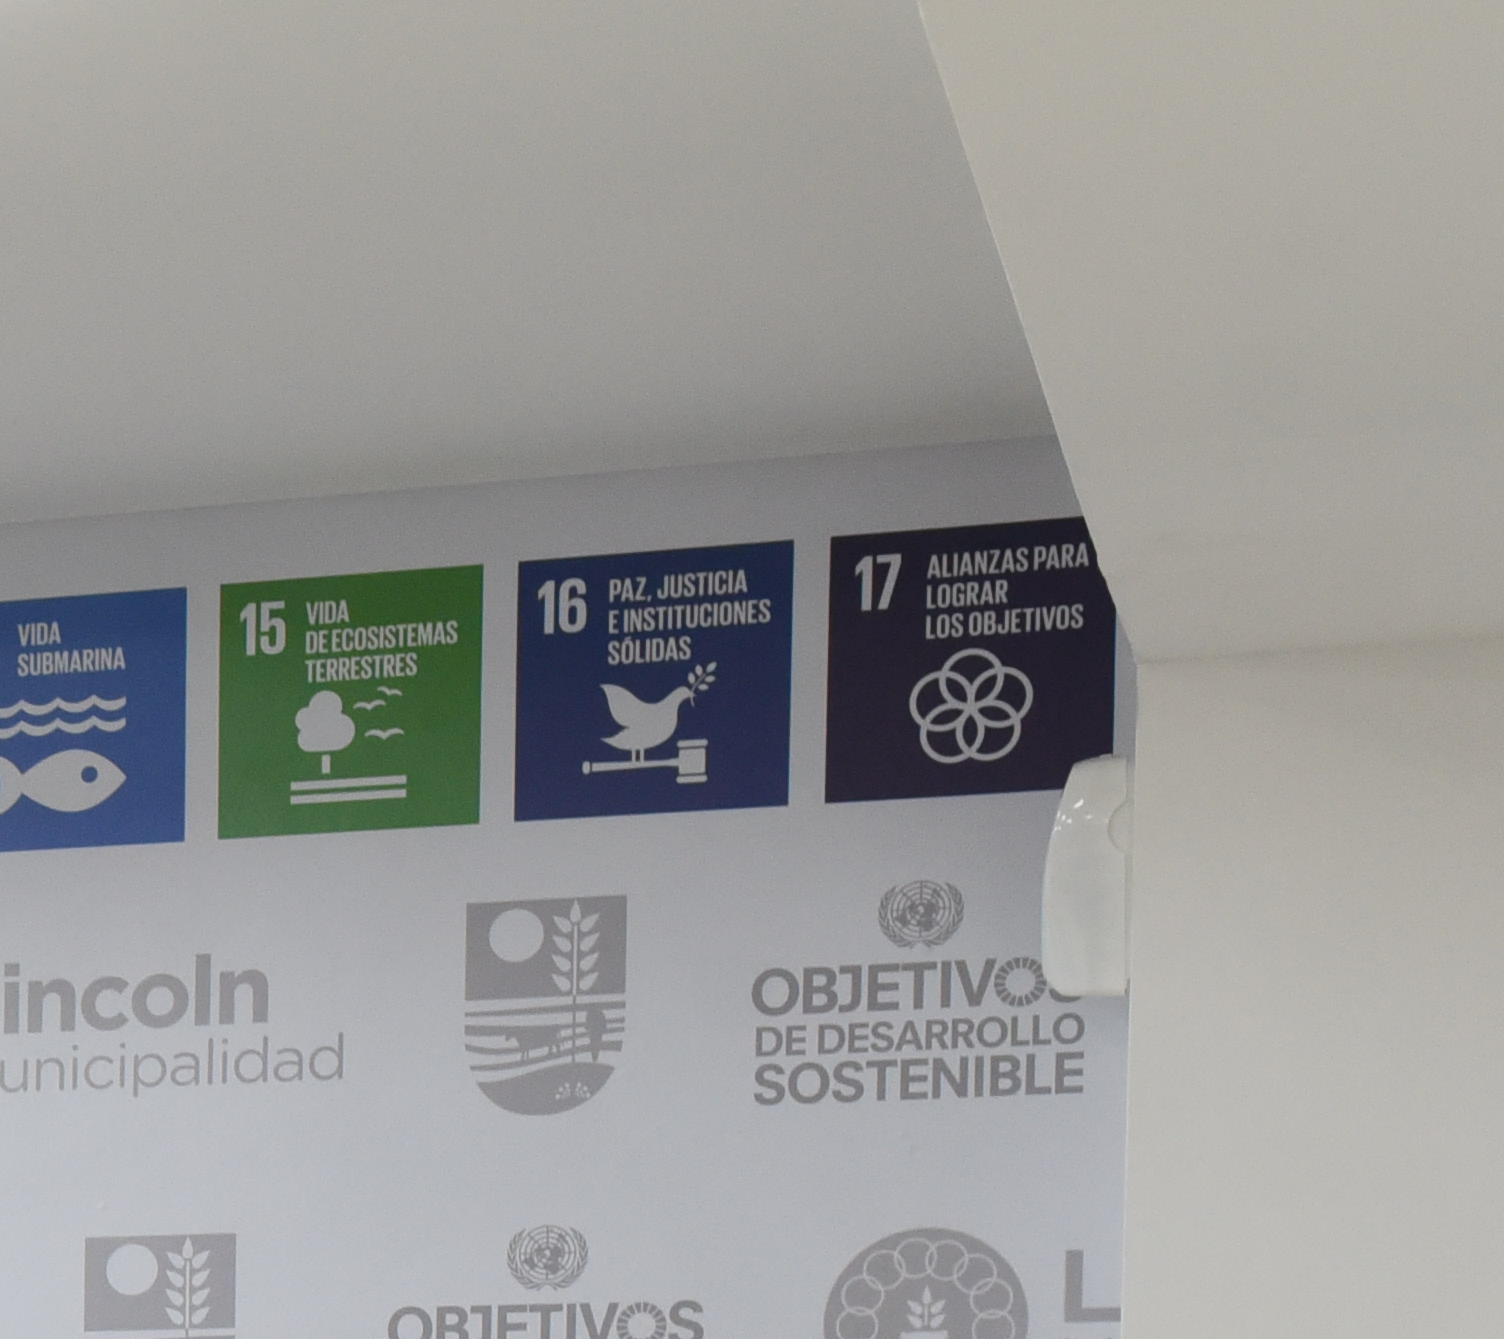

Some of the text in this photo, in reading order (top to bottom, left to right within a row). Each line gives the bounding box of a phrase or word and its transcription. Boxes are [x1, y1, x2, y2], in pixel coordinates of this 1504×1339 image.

[928, 543, 1088, 578] ALIANZAS PARA
[657, 570, 747, 599] JUSTICIA
[856, 554, 901, 611] 17
[927, 580, 1007, 608] LOGRAR
[307, 600, 349, 624] VIDA
[538, 578, 586, 634] 16
[609, 599, 770, 633] E INSTITUCIONES
[926, 604, 1083, 639] LOS OBJETIVOS
[18, 622, 61, 646] VIDA
[240, 601, 285, 656] 15
[306, 621, 457, 654] DE ECOSISTEMAS
[18, 647, 125, 676] SUBMARINA
[608, 636, 691, 664] SÓLIDAS
[305, 653, 417, 682] TERRESTRES
[752, 956, 1082, 1016] OBJETIVO
[756, 1013, 1085, 1057] DE DESARROLLO
[754, 1051, 1084, 1105] SOSTENIBLE
